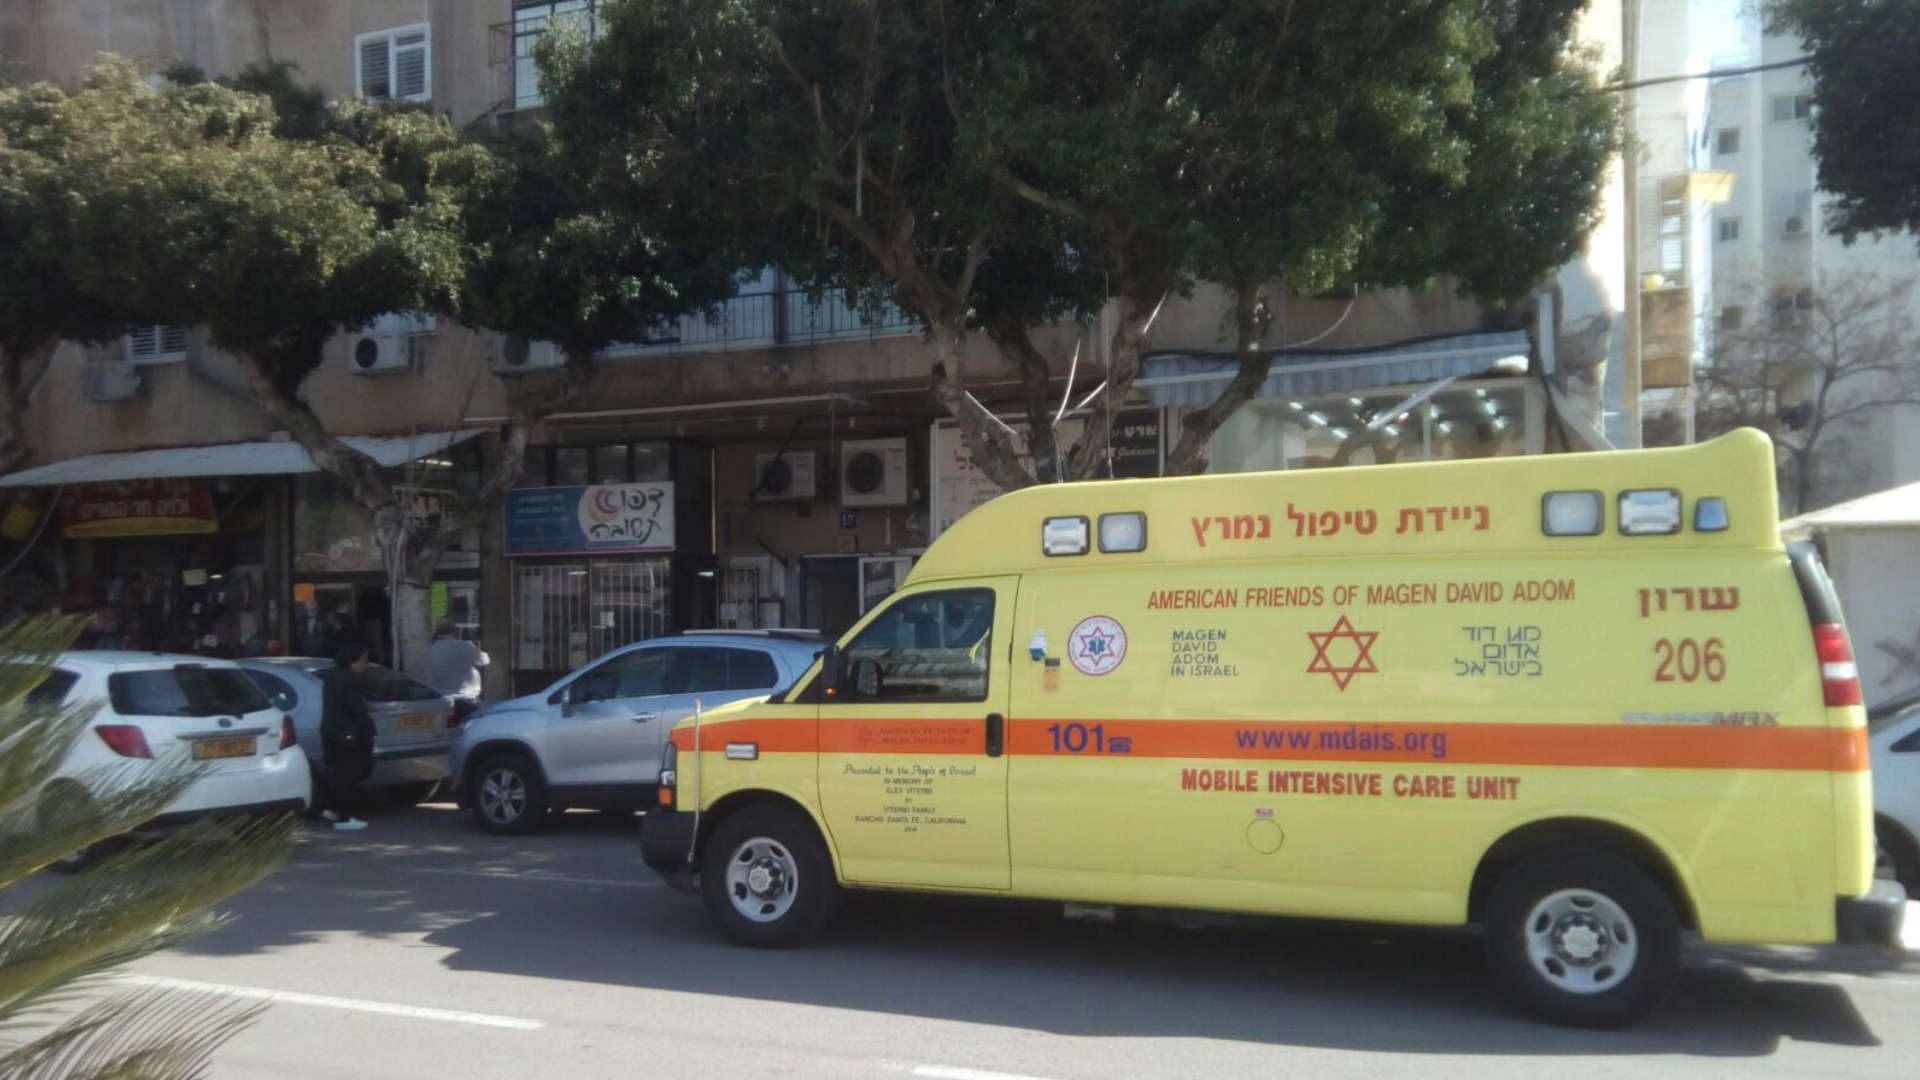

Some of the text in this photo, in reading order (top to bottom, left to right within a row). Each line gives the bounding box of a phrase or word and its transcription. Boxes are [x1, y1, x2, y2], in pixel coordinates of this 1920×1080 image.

[1191, 503, 1491, 547] ניידת טיפול נמרץ
[1147, 579, 1576, 609] AMERICAN FRIENDS OF MAGEN DAVID ADOM
[1637, 586, 1741, 618] שרון
[1172, 629, 1227, 641] MAGEN
[1461, 626, 1497, 642] דוד
[1172, 641, 1218, 653] DAVID
[1483, 643, 1541, 659] אדום
[1172, 653, 1219, 665] ADOM
[1454, 658, 1542, 676] בישראל
[1653, 637, 1726, 683] 206
[1171, 665, 1239, 677] IN ISRAEL
[1049, 723, 1104, 752] 101
[1235, 726, 1448, 759] www.mdais.org
[1181, 769, 1520, 800] MOBILE INTENSIVE CARE UNIT
